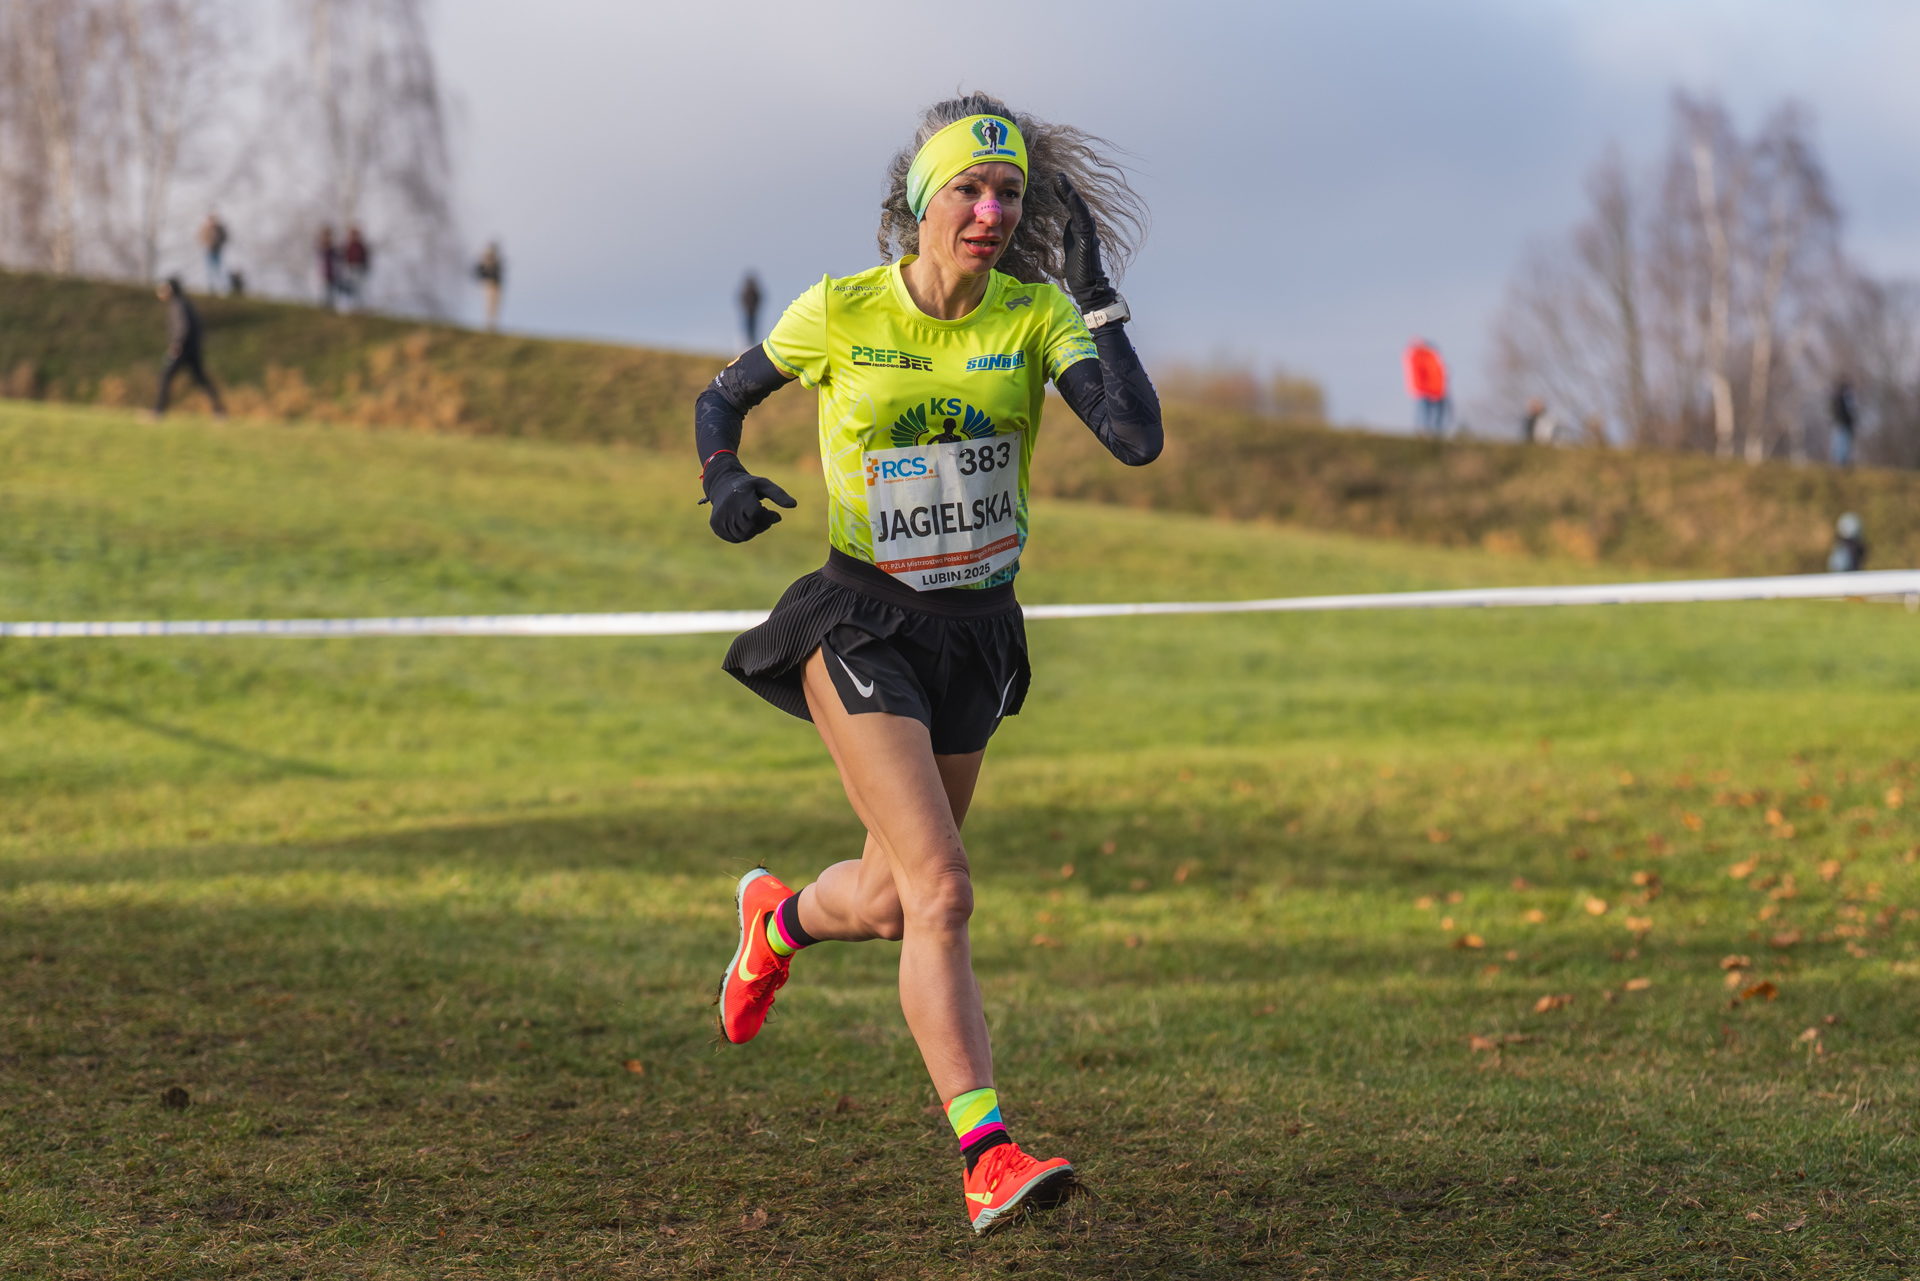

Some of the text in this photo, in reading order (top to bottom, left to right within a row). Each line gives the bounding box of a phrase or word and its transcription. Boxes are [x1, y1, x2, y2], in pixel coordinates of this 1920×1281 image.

[930, 398, 962, 416] KS
[959, 442, 1011, 476] 383
[878, 490, 1012, 543] JAGIELSKA
[907, 558, 943, 568] Mistrzostwa
[943, 554, 962, 562] Polski
[922, 562, 991, 586] LUBIN 2025
